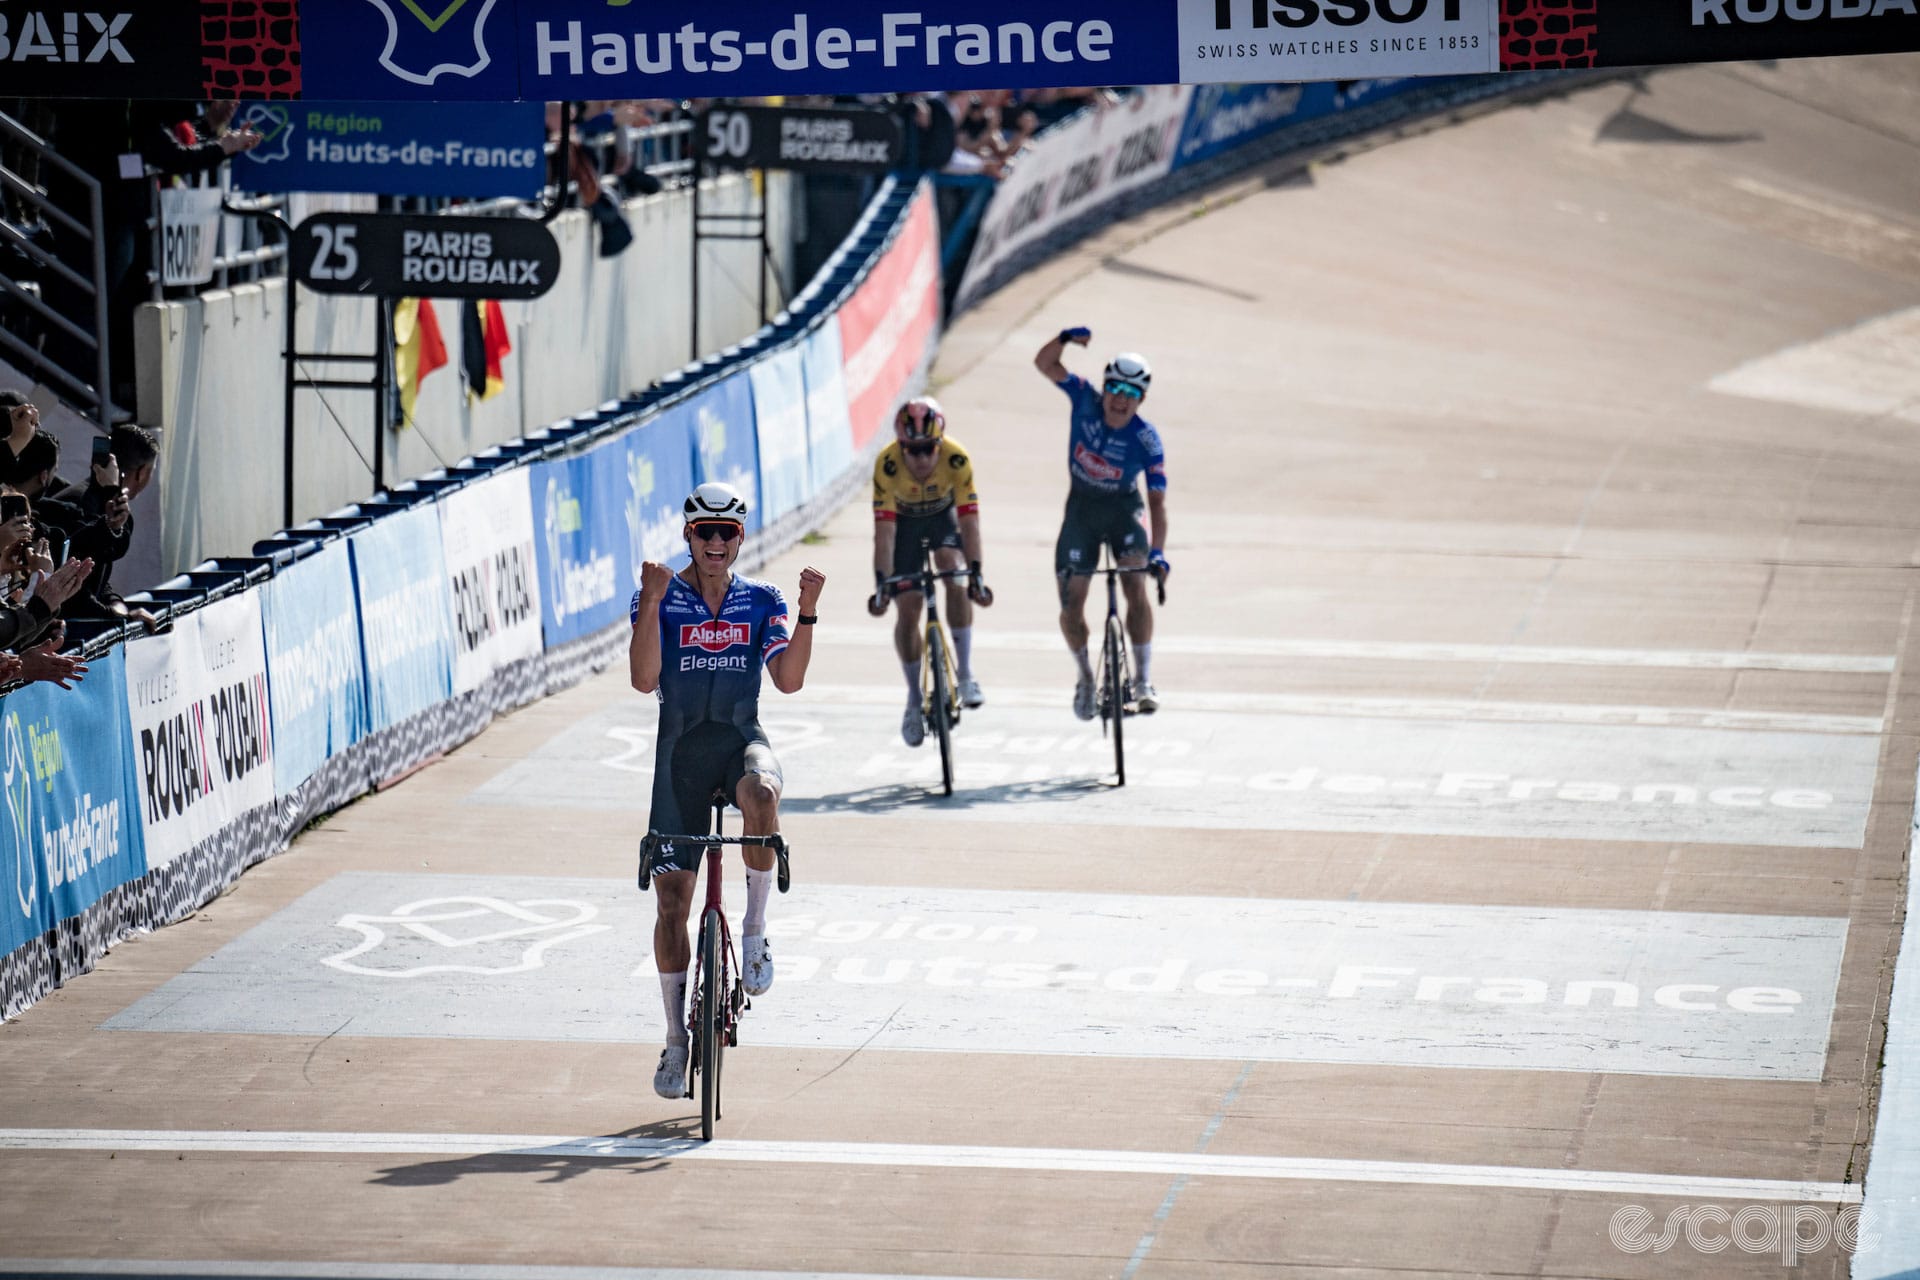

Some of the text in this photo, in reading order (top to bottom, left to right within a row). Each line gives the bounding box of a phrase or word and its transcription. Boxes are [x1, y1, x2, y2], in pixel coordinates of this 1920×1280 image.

[0, 11, 136, 63] AIX
[536, 12, 1114, 76] Hauts-de-France
[1198, 35, 1480, 59] SWISS WATCHES SINCE 1853
[307, 112, 383, 135] Région
[707, 111, 751, 158] 50
[781, 118, 853, 142] PARIS
[306, 138, 537, 169] Hauts-de-France
[780, 139, 890, 163] ROUBAIX
[309, 223, 359, 281] 25
[403, 230, 493, 259] PARIS
[402, 256, 541, 285] ROUBAIX
[689, 625, 743, 643] Alpecin
[680, 655, 748, 672] Elegant
[140, 699, 214, 826] ROUBAIX
[632, 955, 1803, 1014] auts-de-France
